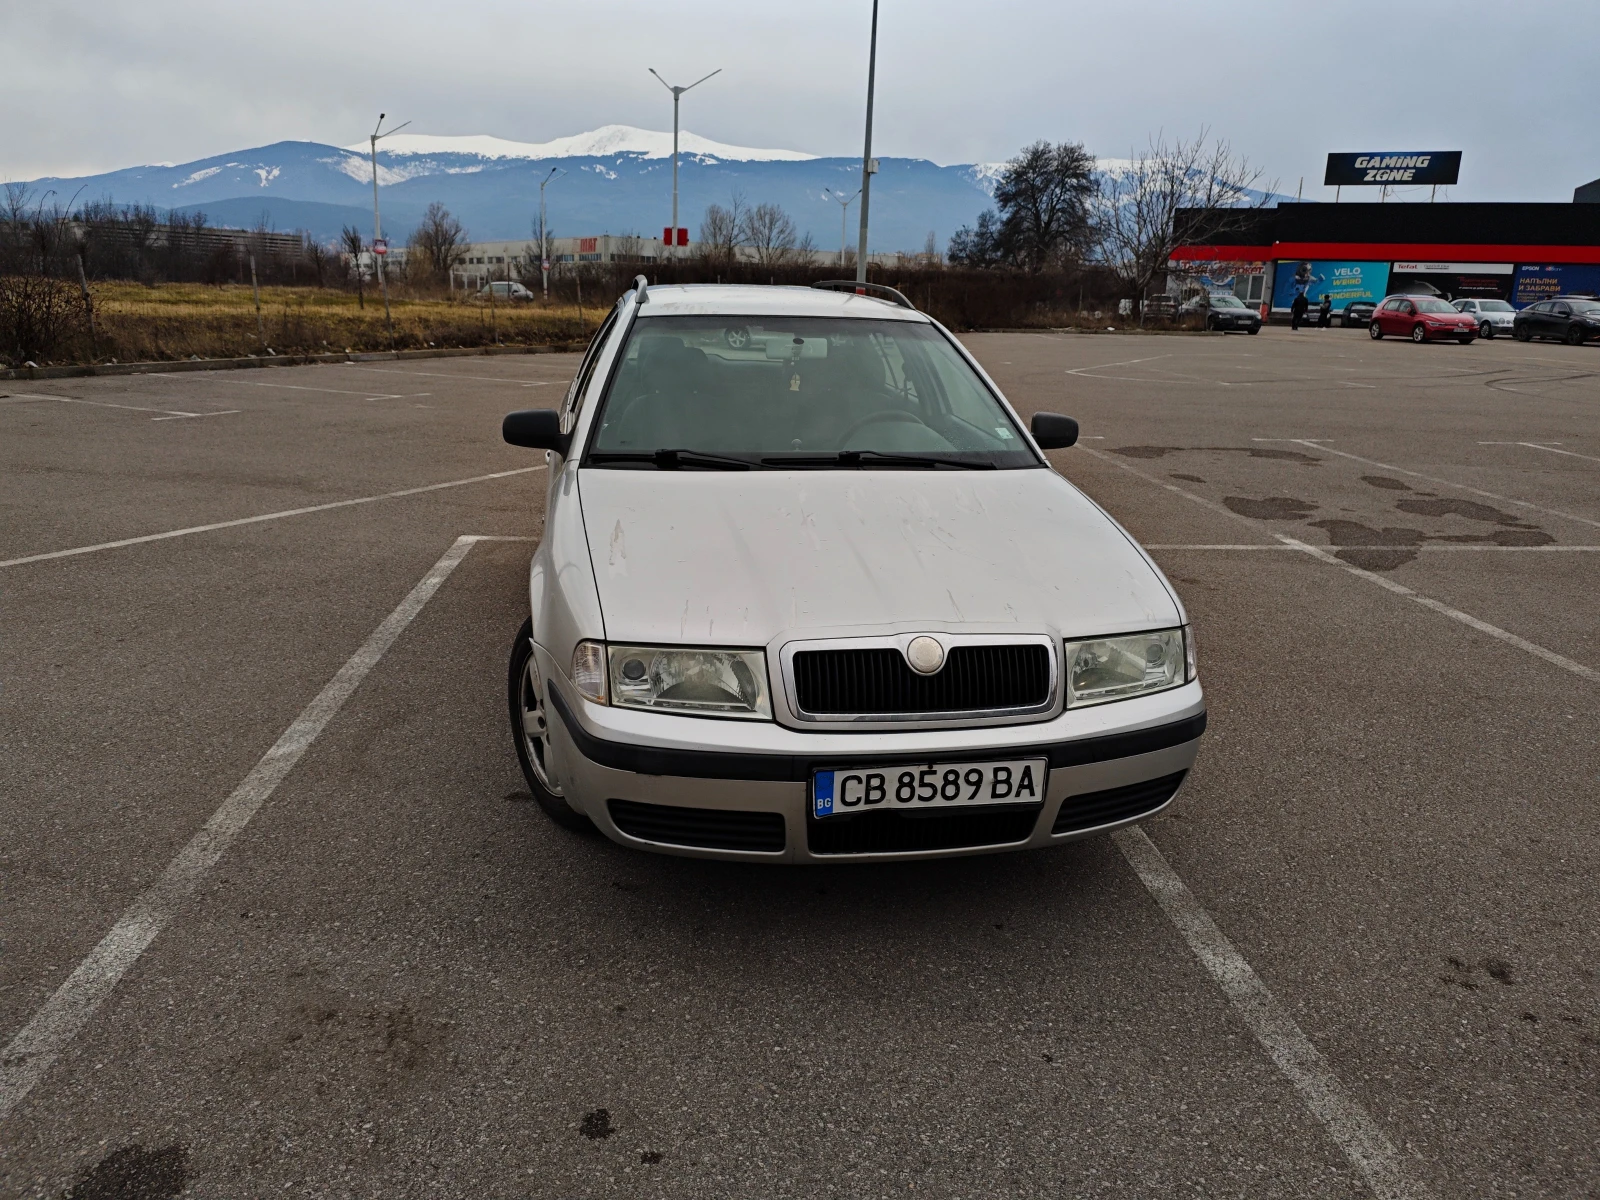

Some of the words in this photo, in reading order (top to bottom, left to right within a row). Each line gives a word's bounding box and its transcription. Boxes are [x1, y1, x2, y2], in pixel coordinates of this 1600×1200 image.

[1354, 155, 1432, 168] GAMING
[1363, 169, 1416, 181] ZONE
[1334, 267, 1361, 276] VELO
[1333, 278, 1362, 286] WEIRD
[1318, 291, 1373, 300] WONDERFUL
[840, 772, 887, 807] CB
[895, 768, 984, 803] 8589
[990, 764, 1036, 799] BA
[817, 797, 832, 810] BG
